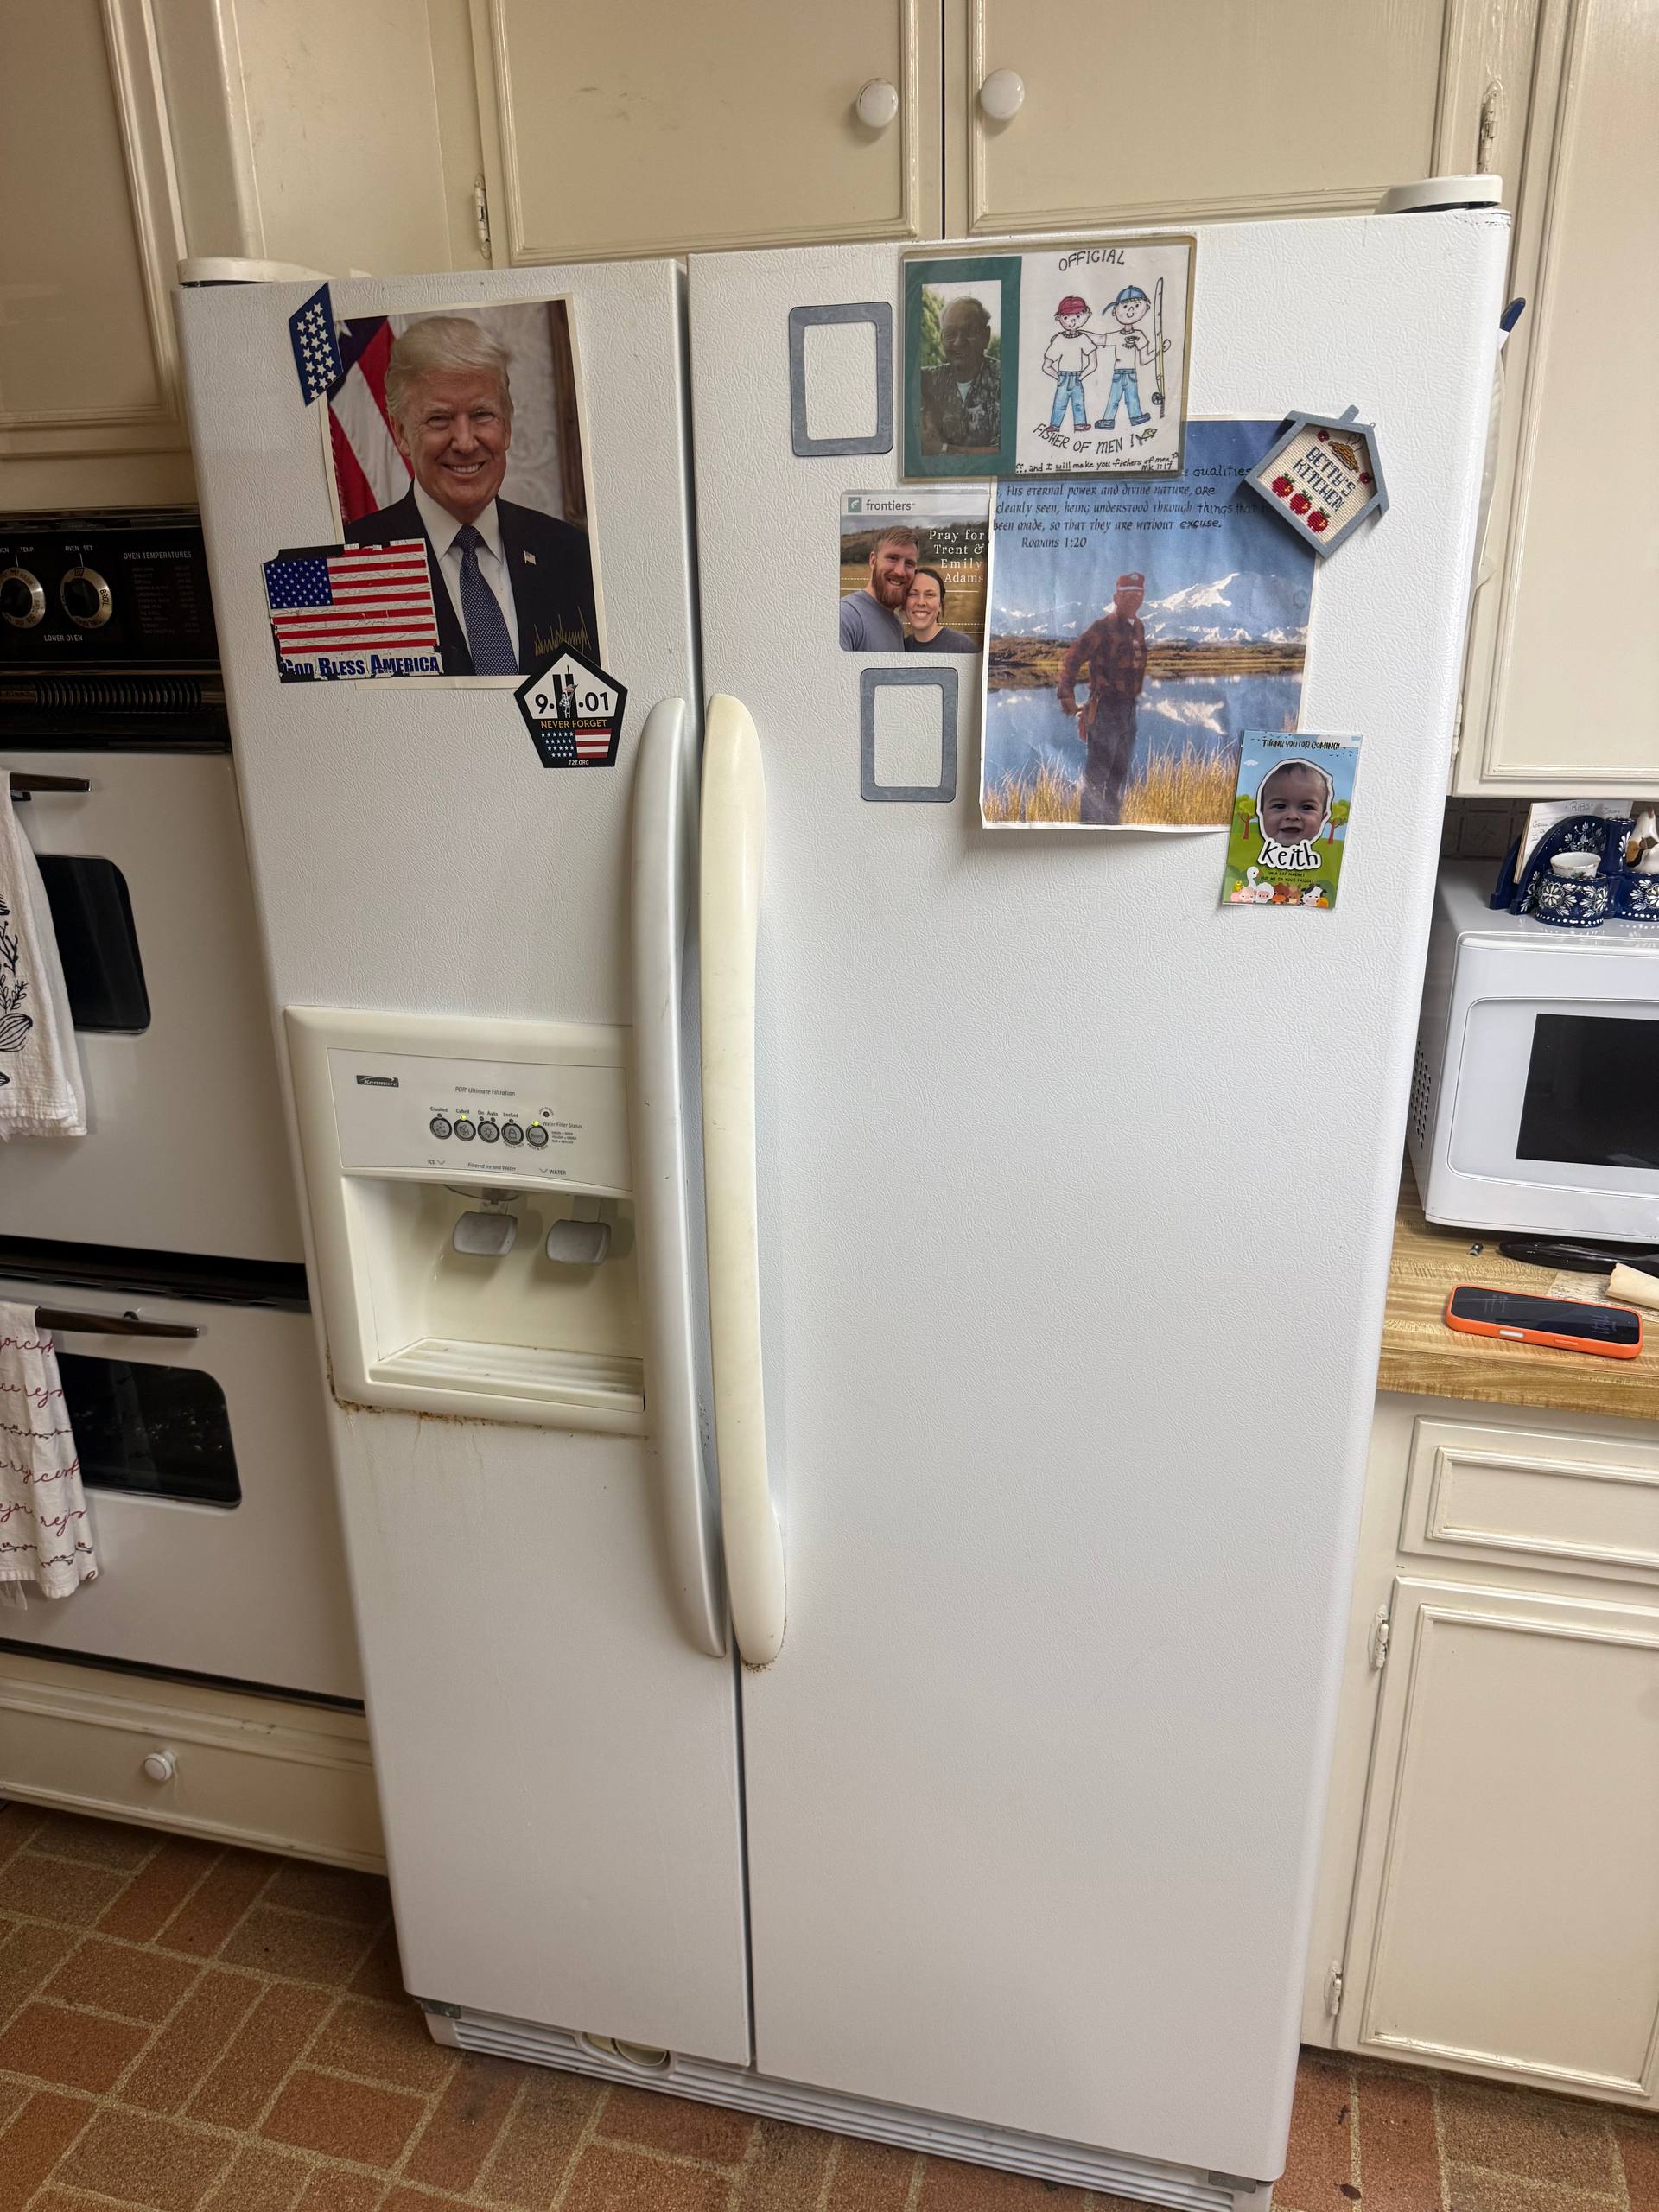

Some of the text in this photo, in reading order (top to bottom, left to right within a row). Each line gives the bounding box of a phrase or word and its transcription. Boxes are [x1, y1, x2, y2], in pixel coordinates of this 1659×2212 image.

[1058, 249, 1125, 271] OFFICIAL
[1033, 423, 1070, 448] FISHER
[1072, 440, 1092, 453] OF
[1096, 438, 1122, 454] MEN
[1055, 461, 1071, 472] will
[1072, 460, 1094, 469] make
[1096, 461, 1111, 471] you
[1144, 455, 1154, 464] of
[1306, 446, 1357, 497] BETTY'S
[1007, 486, 1023, 496] His
[1027, 484, 1064, 496] eternal
[1067, 486, 1097, 499] power
[1101, 484, 1118, 496] and
[1122, 483, 1150, 495] divine
[1292, 458, 1345, 512] KITCHEN
[866, 499, 912, 511] frontiers
[995, 500, 1033, 516] clearly
[1036, 504, 1060, 515] seen,
[1065, 500, 1090, 513] being
[1093, 499, 1149, 513] understood
[1197, 503, 1232, 517] things
[994, 518, 1222, 534] been made, so that they are without excuse.
[929, 529, 985, 543] Pray for
[1021, 537, 1087, 548] Romans 1:20
[143, 550, 192, 560] TEMPERATURES
[934, 543, 985, 555] Trent &
[940, 558, 982, 571] Emily
[944, 572, 984, 583] Adams
[540, 719, 607, 729] NEVER FORGET
[1261, 841, 1319, 867] Keith
[363, 1078, 399, 1087] Kenmore
